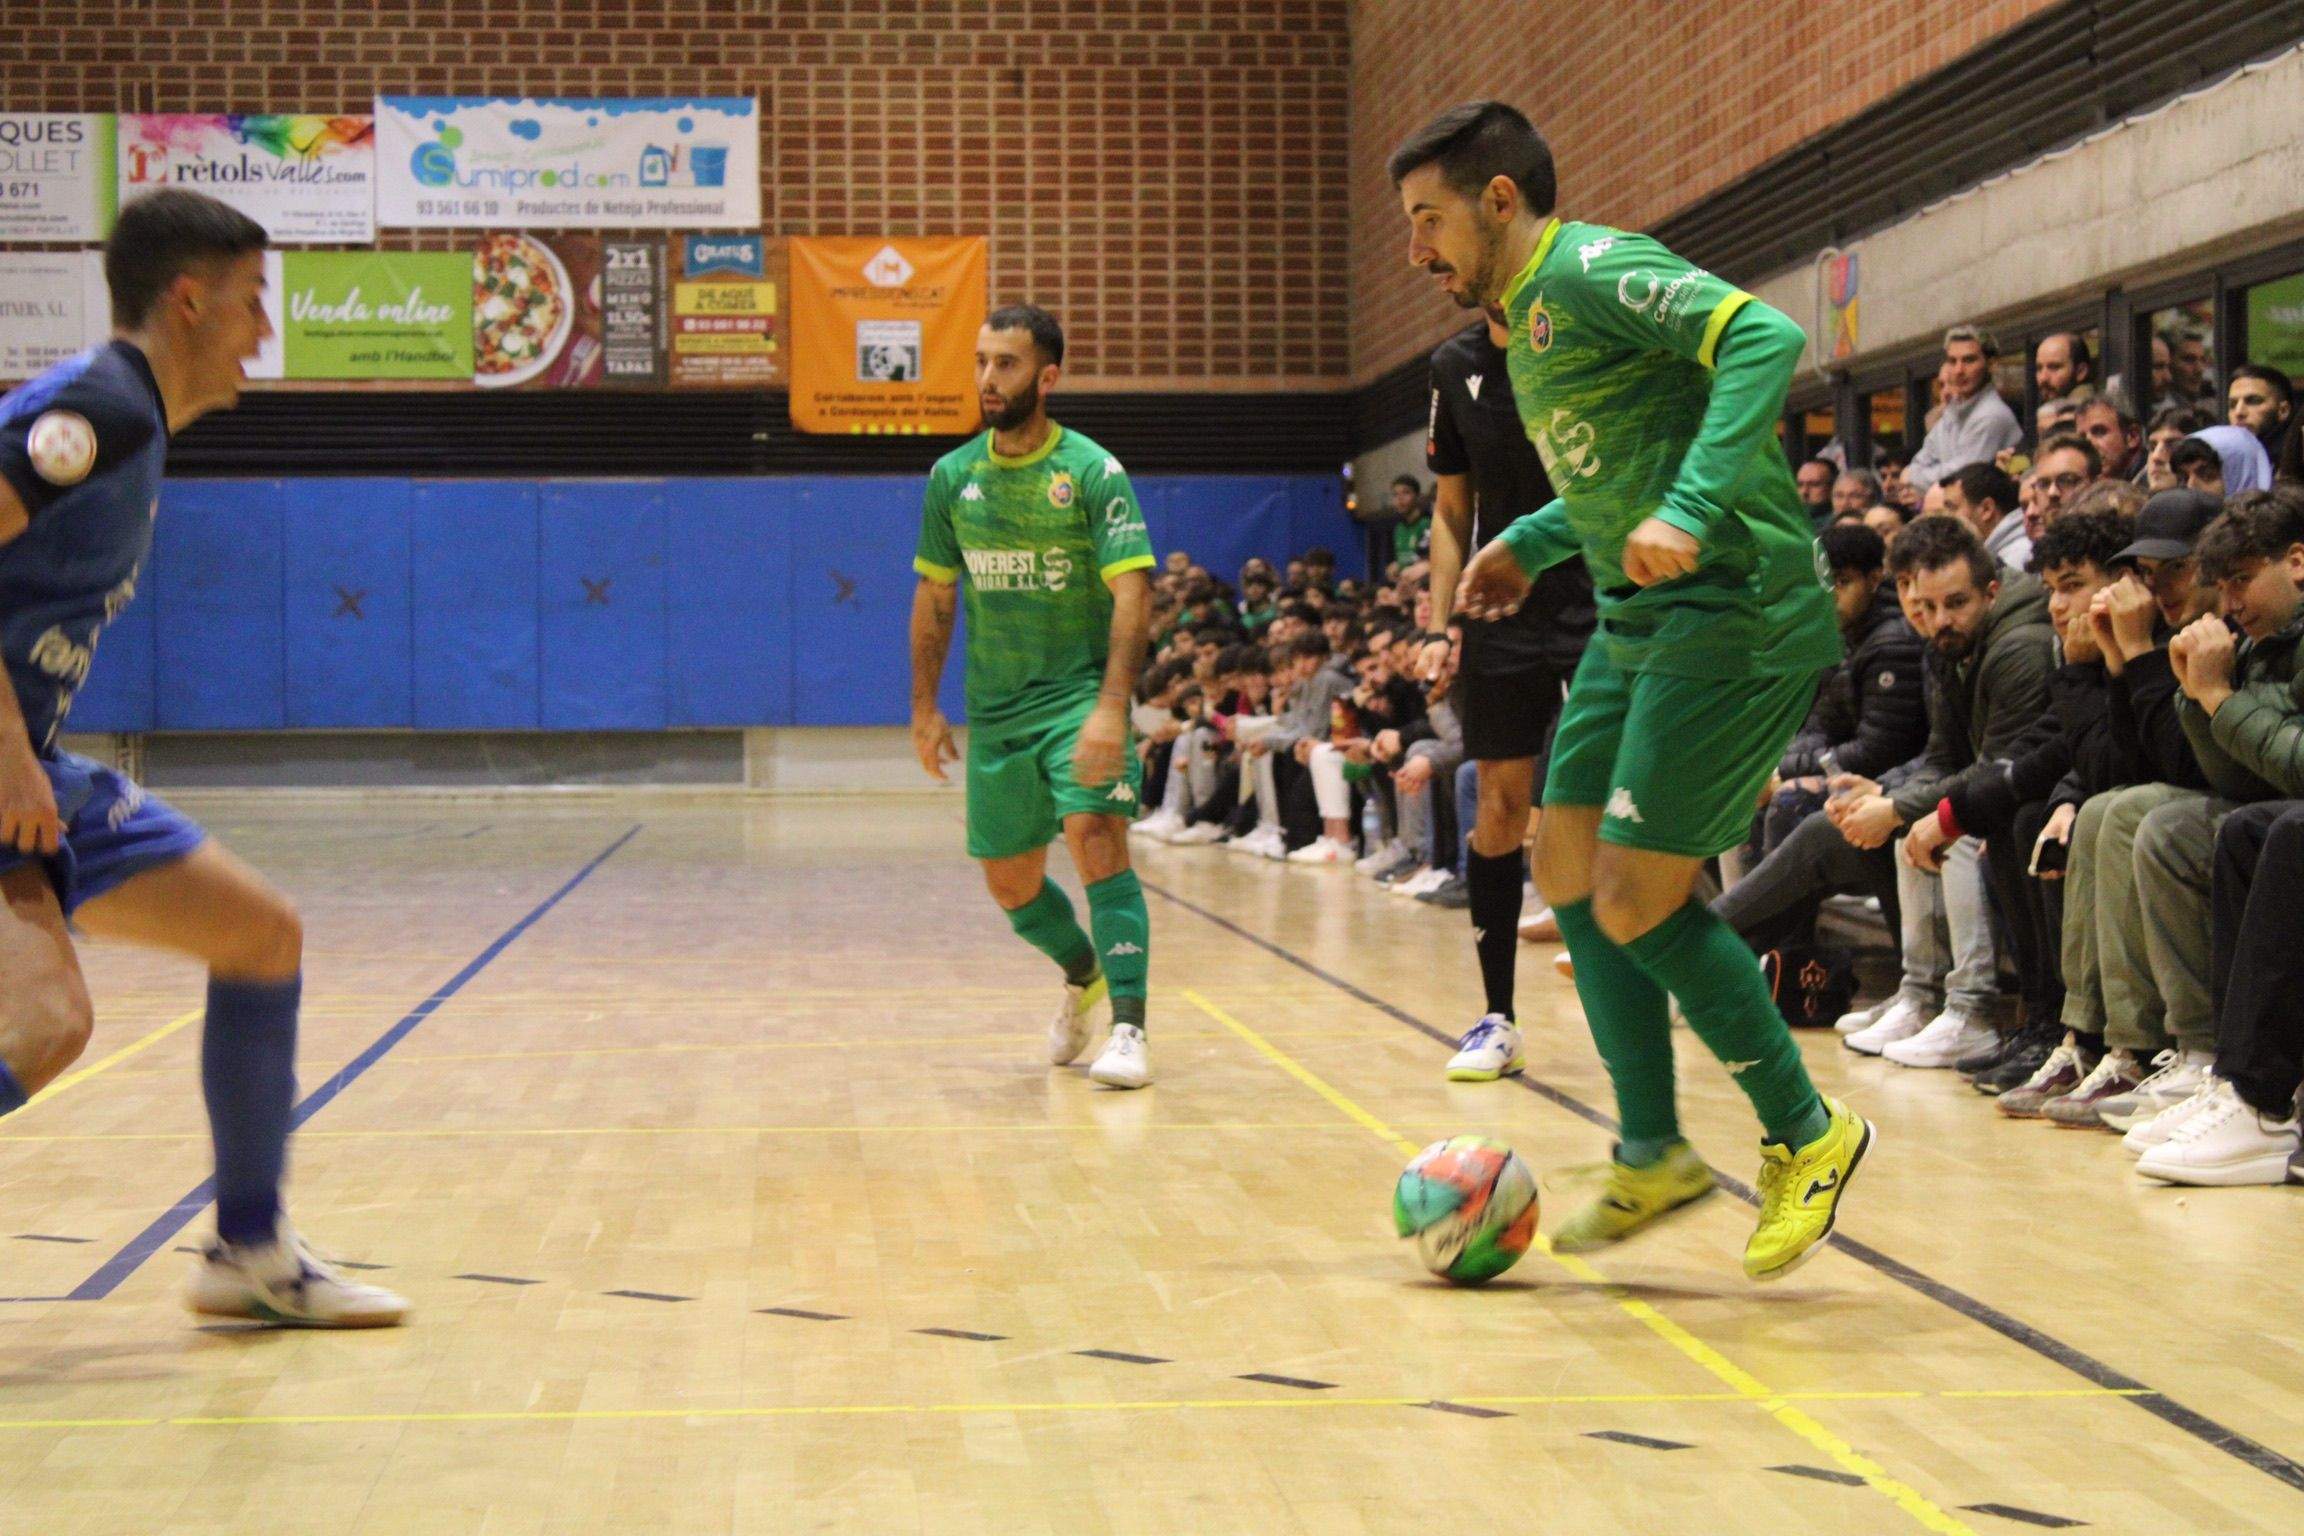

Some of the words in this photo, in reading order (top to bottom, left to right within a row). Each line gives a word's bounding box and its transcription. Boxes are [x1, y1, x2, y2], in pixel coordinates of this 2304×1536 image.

[517, 200, 580, 215] Productes
[585, 200, 599, 215] de
[603, 200, 642, 217] Neteja
[647, 200, 724, 215] Professional
[290, 287, 372, 324] Venda
[376, 286, 454, 325] online
